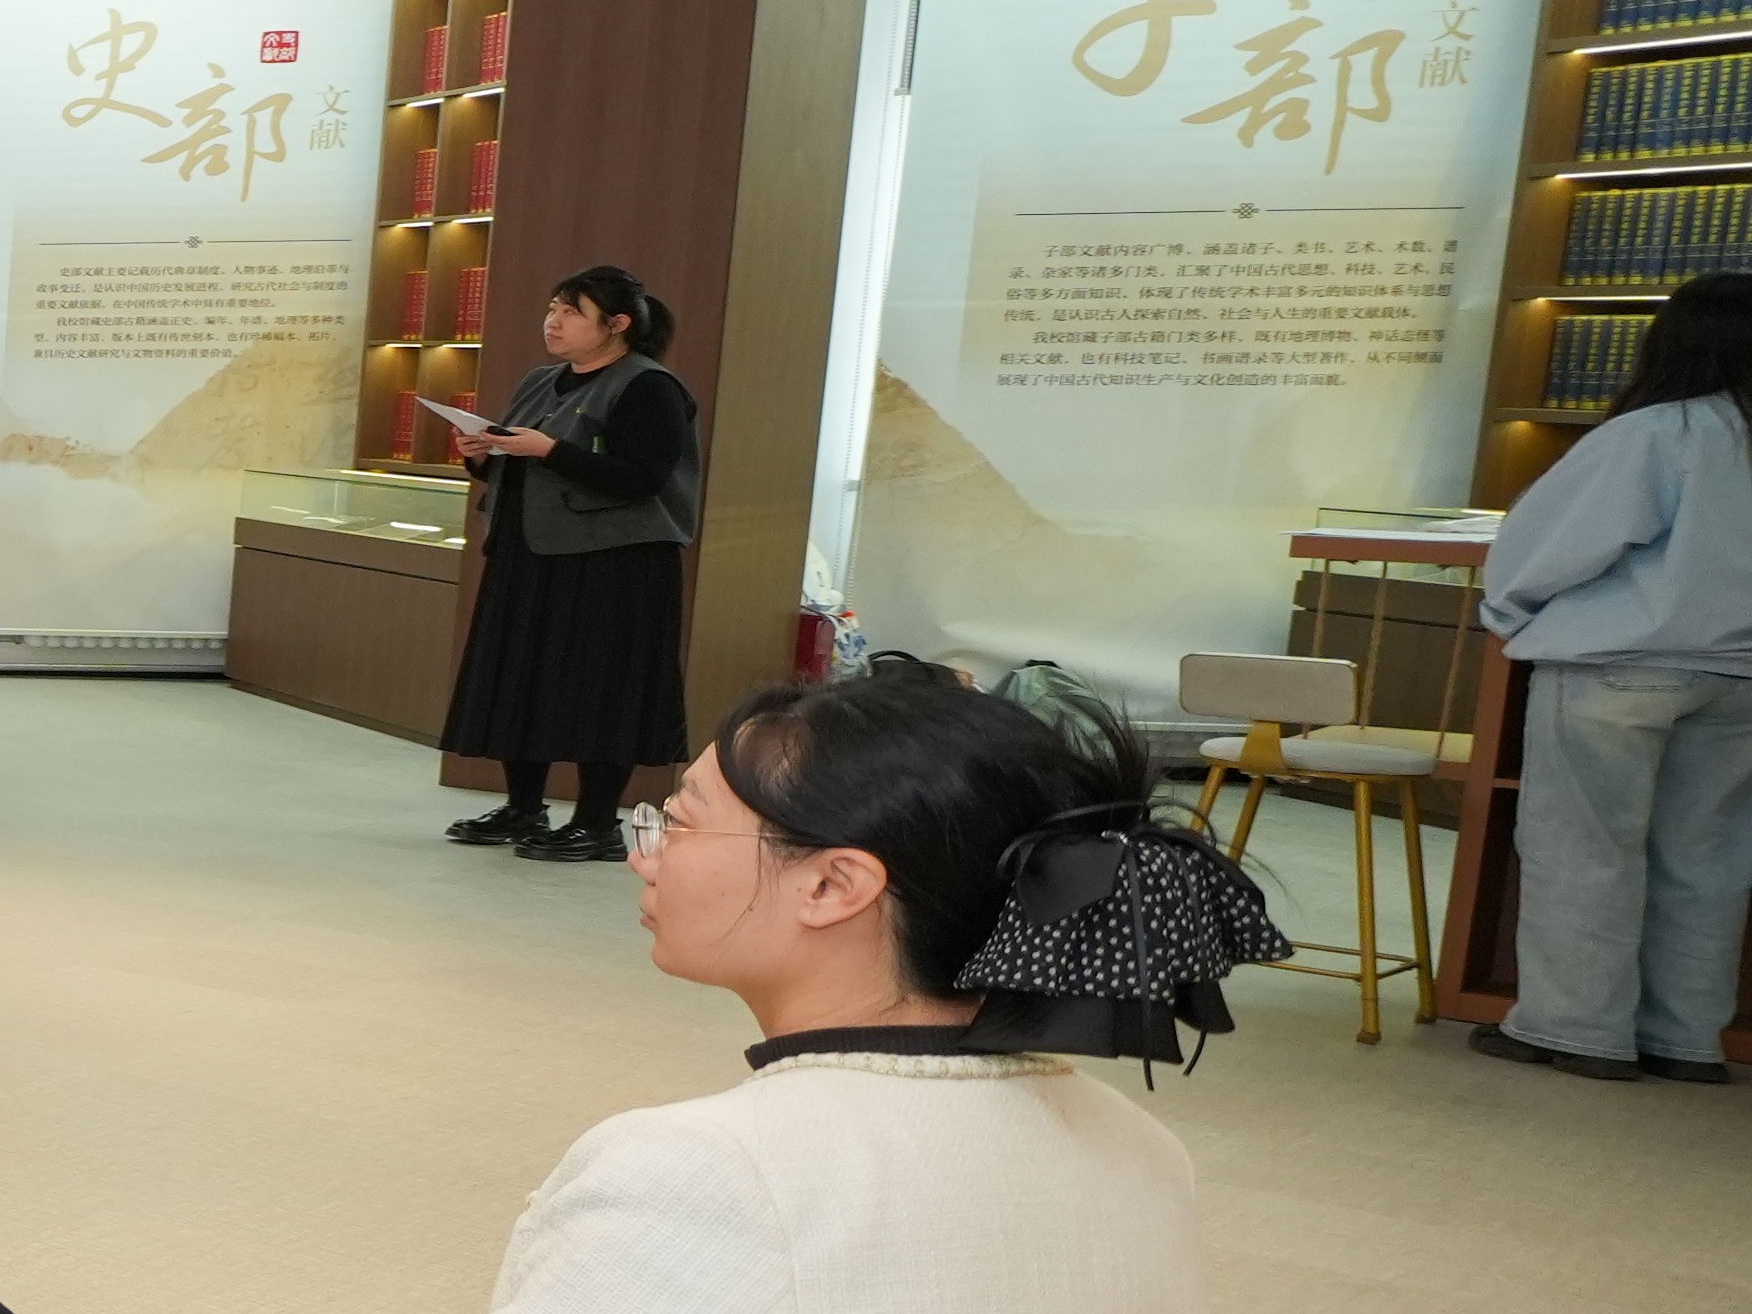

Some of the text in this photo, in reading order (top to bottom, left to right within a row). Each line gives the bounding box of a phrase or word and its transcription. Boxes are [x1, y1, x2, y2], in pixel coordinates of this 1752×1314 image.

[1419, 0, 1480, 88] 文献
[62, 9, 294, 202] 史部
[308, 85, 350, 150] 文献
